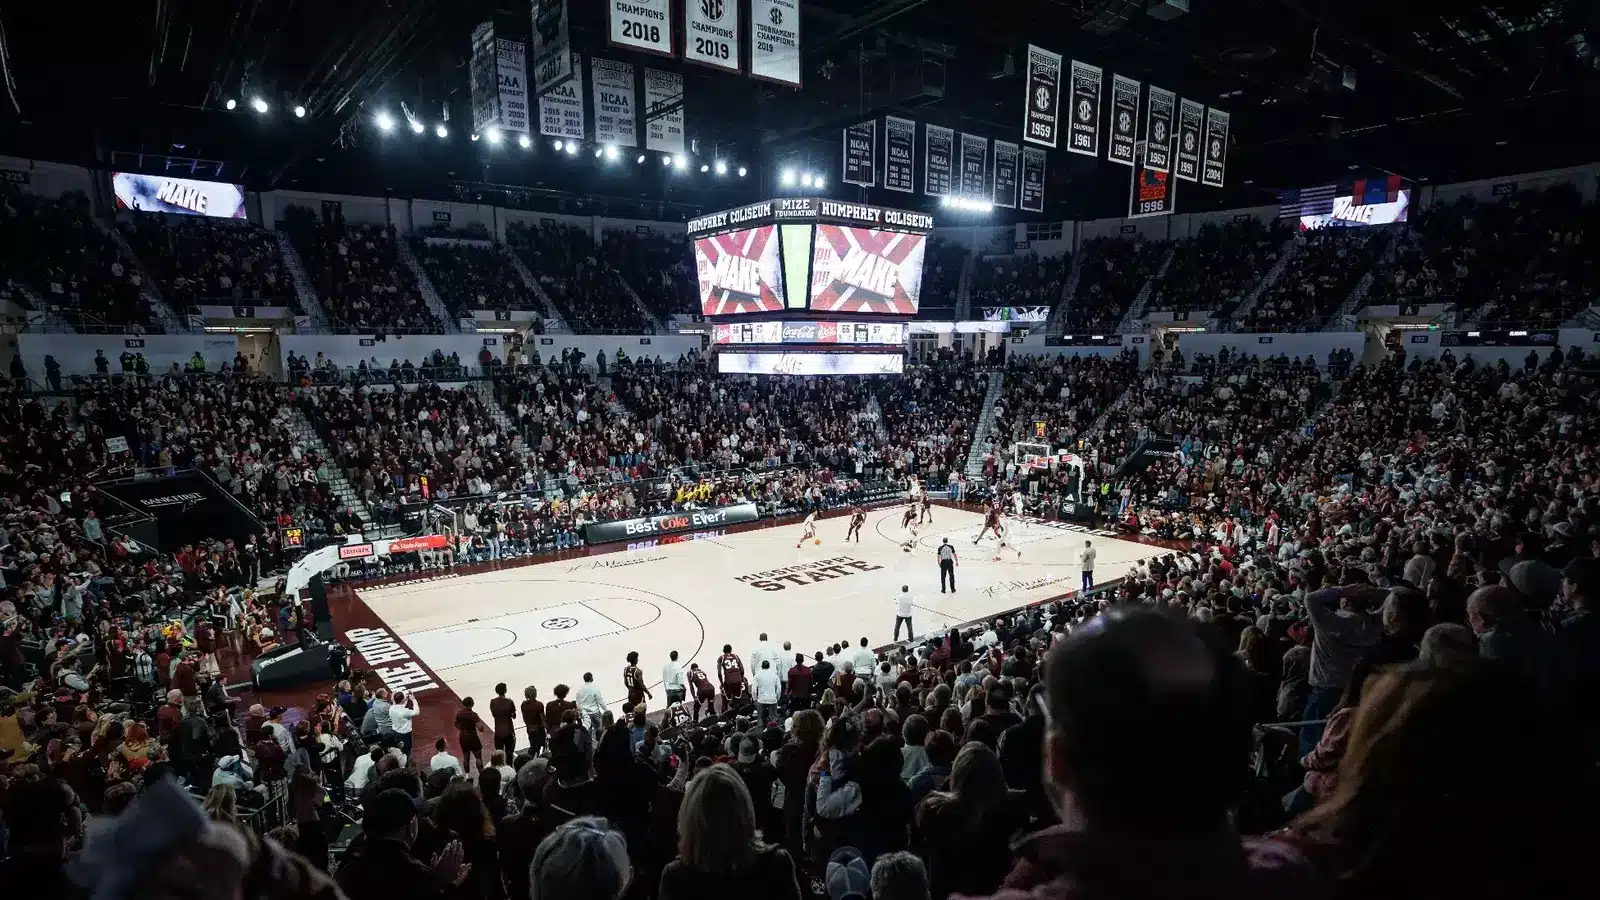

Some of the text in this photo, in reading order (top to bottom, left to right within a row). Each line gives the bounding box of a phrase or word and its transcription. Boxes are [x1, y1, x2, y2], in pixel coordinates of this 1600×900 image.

[616, 2, 664, 20] CHAMPIONS
[770, 8, 782, 24] SEC
[622, 20, 660, 43] 2018
[692, 21, 733, 38] CHAMPIONS
[756, 24, 795, 38] TOURNAMENT
[756, 32, 795, 46] CHAMPIONS
[696, 38, 728, 60] 2019
[758, 42, 774, 52] 2019
[592, 58, 634, 72] MISSISSIPPI
[498, 74, 520, 88] CAA
[644, 70, 683, 84] MISSISSIPPI
[543, 96, 580, 106] TOURNAMENT
[600, 92, 628, 106] NCAA
[601, 104, 620, 112] SWEET
[1032, 122, 1050, 138] 1959
[850, 140, 870, 151] NCAA
[1074, 134, 1090, 148] 1961
[891, 147, 909, 158] NCAA
[1114, 144, 1130, 158] 1962
[1150, 152, 1166, 164] 1963
[968, 162, 980, 172] NIT
[1180, 162, 1193, 174] 1991
[1206, 168, 1220, 180] 2004
[156, 179, 208, 214] MAKE
[782, 200, 810, 210] MIZE
[1140, 200, 1164, 214] 1996
[1330, 201, 1371, 223] MAKE
[687, 203, 771, 235] HUMPHREY COLISEUM
[774, 209, 817, 217] FOUNDATION
[822, 201, 933, 228] HUMPHREY COLISEUM
[626, 510, 726, 534] Best Coke Ever?
[734, 556, 854, 582] MISSISSIPPI
[750, 560, 884, 592] STATE
[344, 628, 410, 666] HUMP
[724, 659, 740, 669] 34
[374, 661, 440, 693] THE
[626, 676, 634, 686] 11
